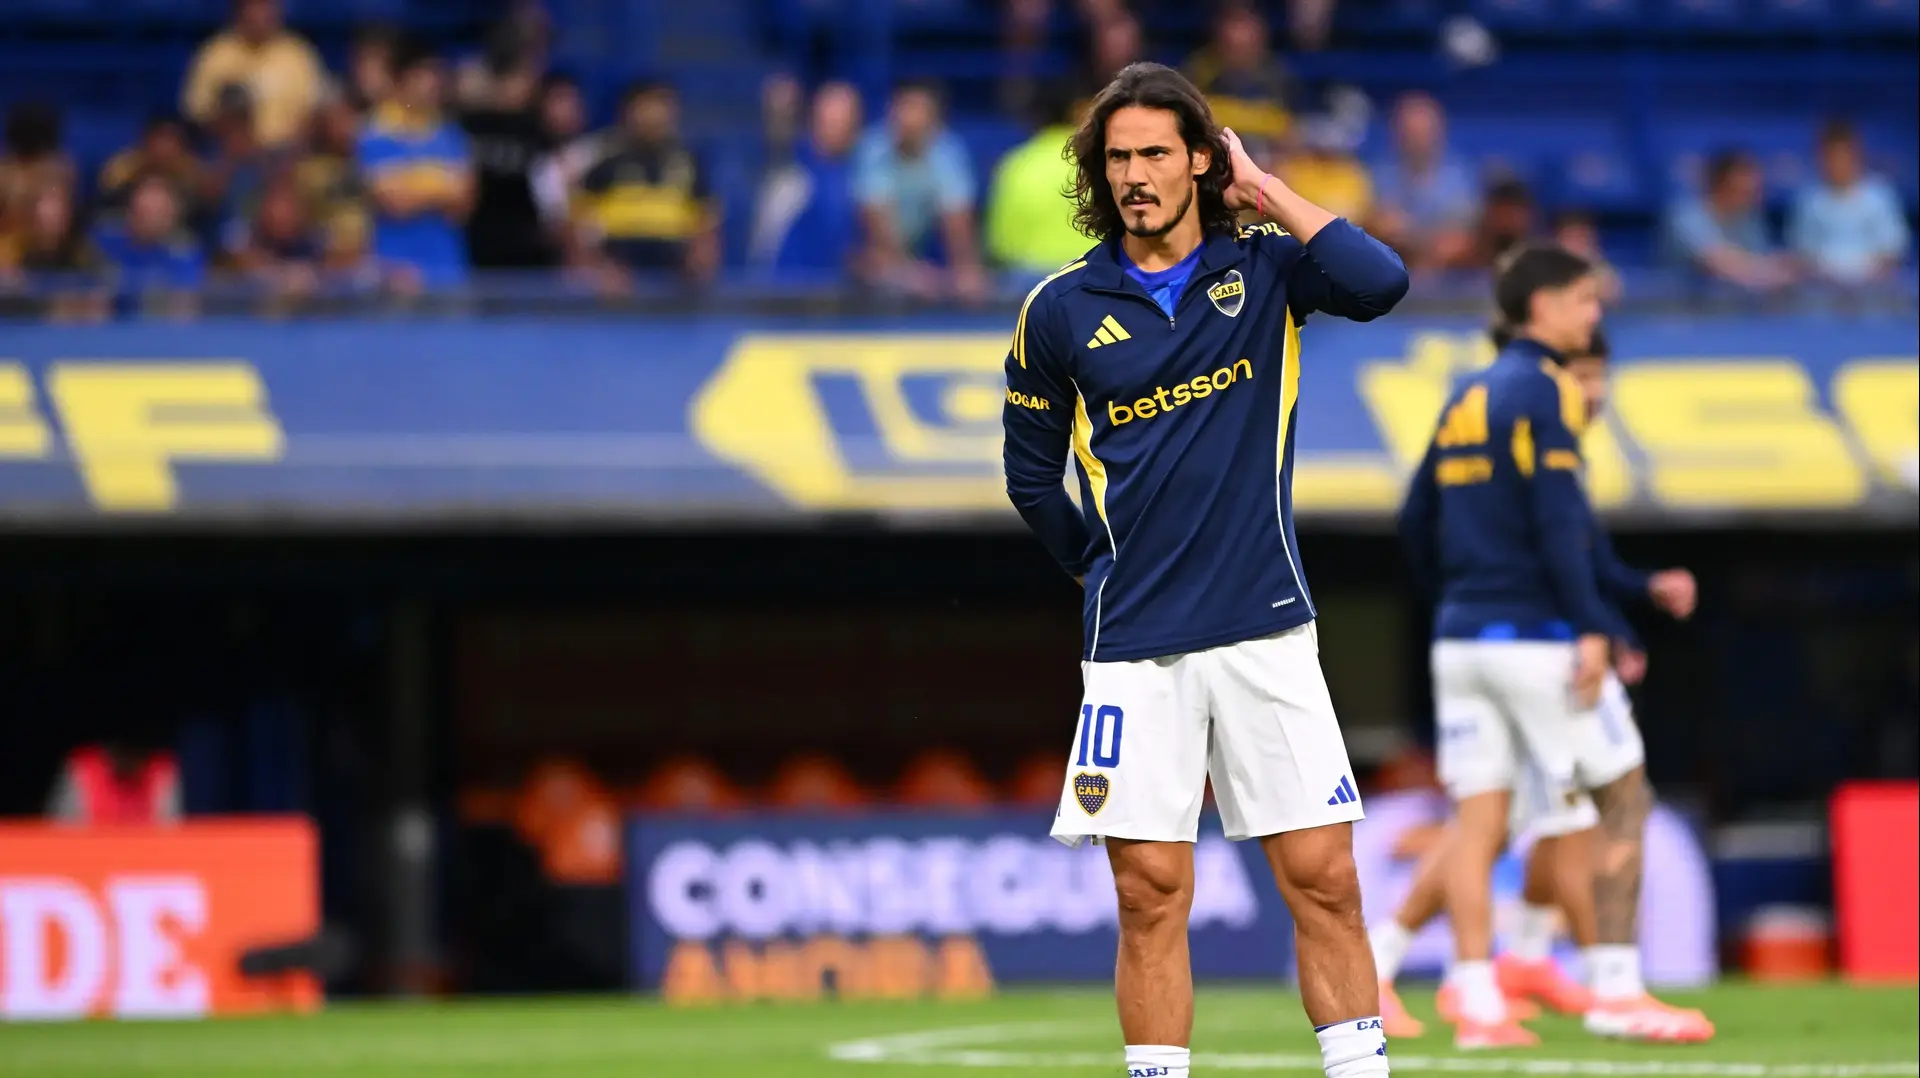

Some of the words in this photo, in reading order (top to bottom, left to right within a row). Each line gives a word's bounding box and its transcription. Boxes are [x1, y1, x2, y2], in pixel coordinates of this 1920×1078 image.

[1213, 283, 1240, 298] CABJ
[1107, 357, 1254, 427] betsson
[0, 357, 286, 513] F
[1076, 703, 1124, 769] 10
[1077, 786, 1106, 796] CABJ
[650, 838, 1257, 935] CONSEGUA
[0, 872, 211, 1022] DE
[1356, 1019, 1383, 1031] CA
